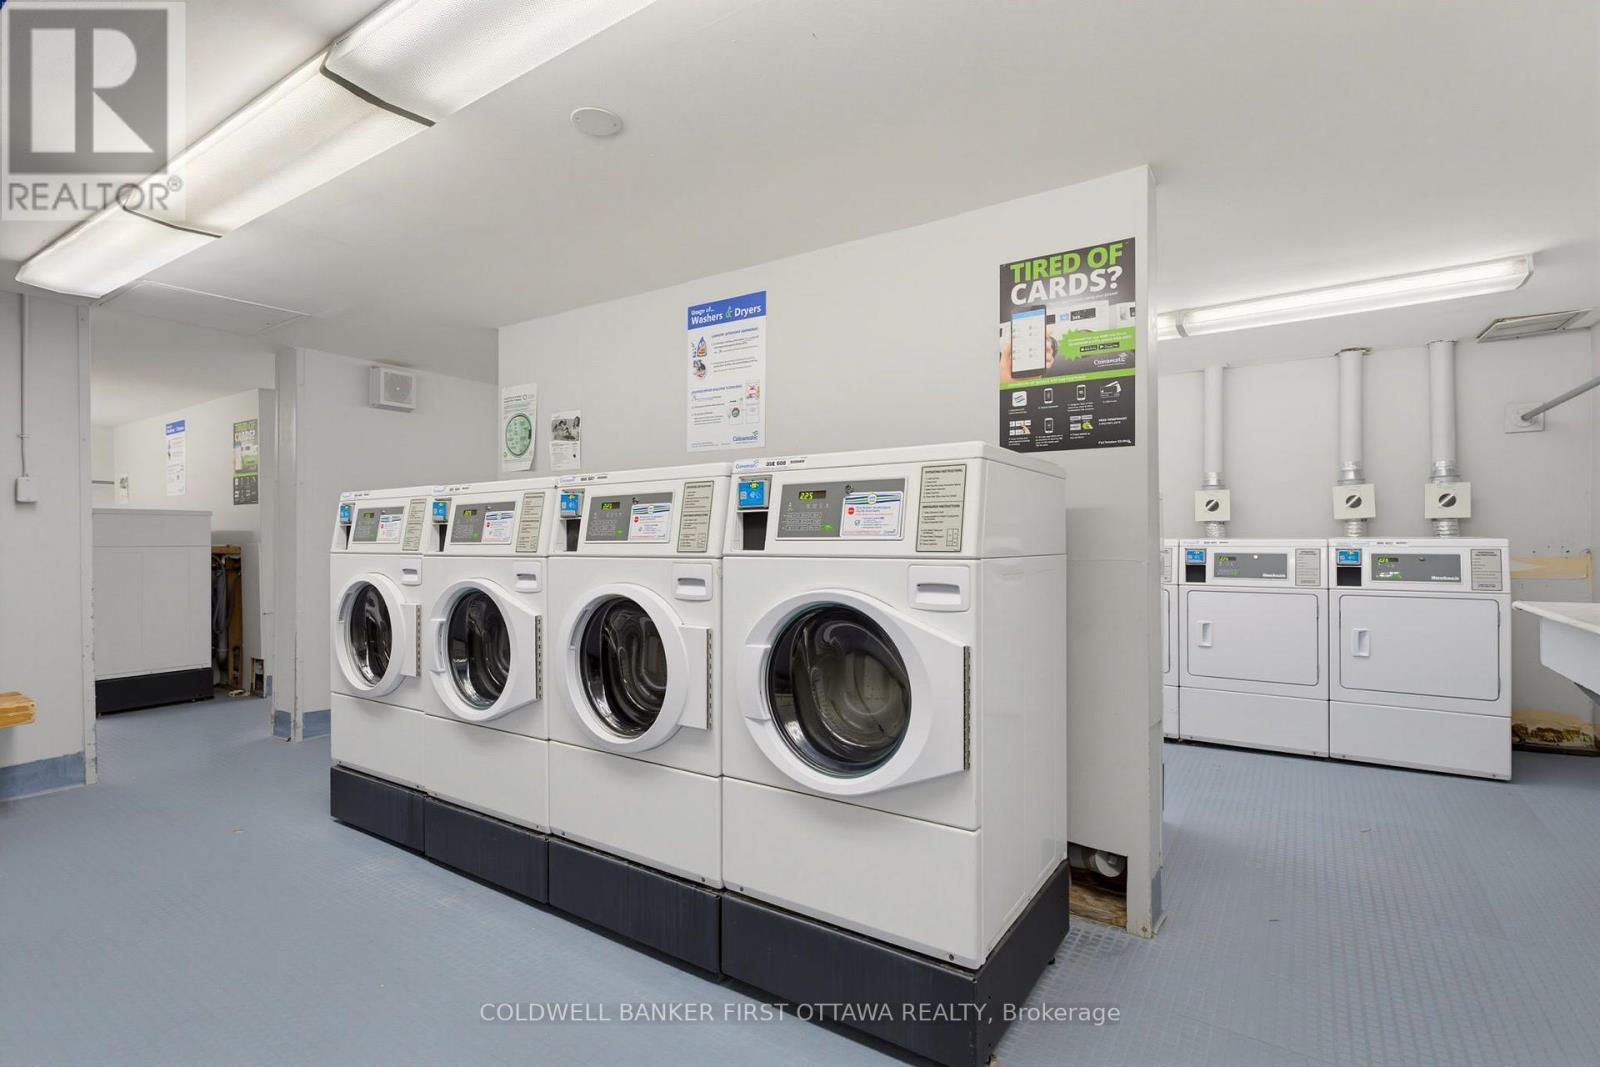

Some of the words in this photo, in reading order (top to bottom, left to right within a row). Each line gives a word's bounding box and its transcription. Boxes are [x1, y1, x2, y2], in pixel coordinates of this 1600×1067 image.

[1010, 253, 1081, 283] TIRED
[1087, 243, 1123, 268] OF
[1010, 266, 1123, 305] CARDS?
[691, 313, 723, 325] Washers
[734, 305, 762, 318] Dryers
